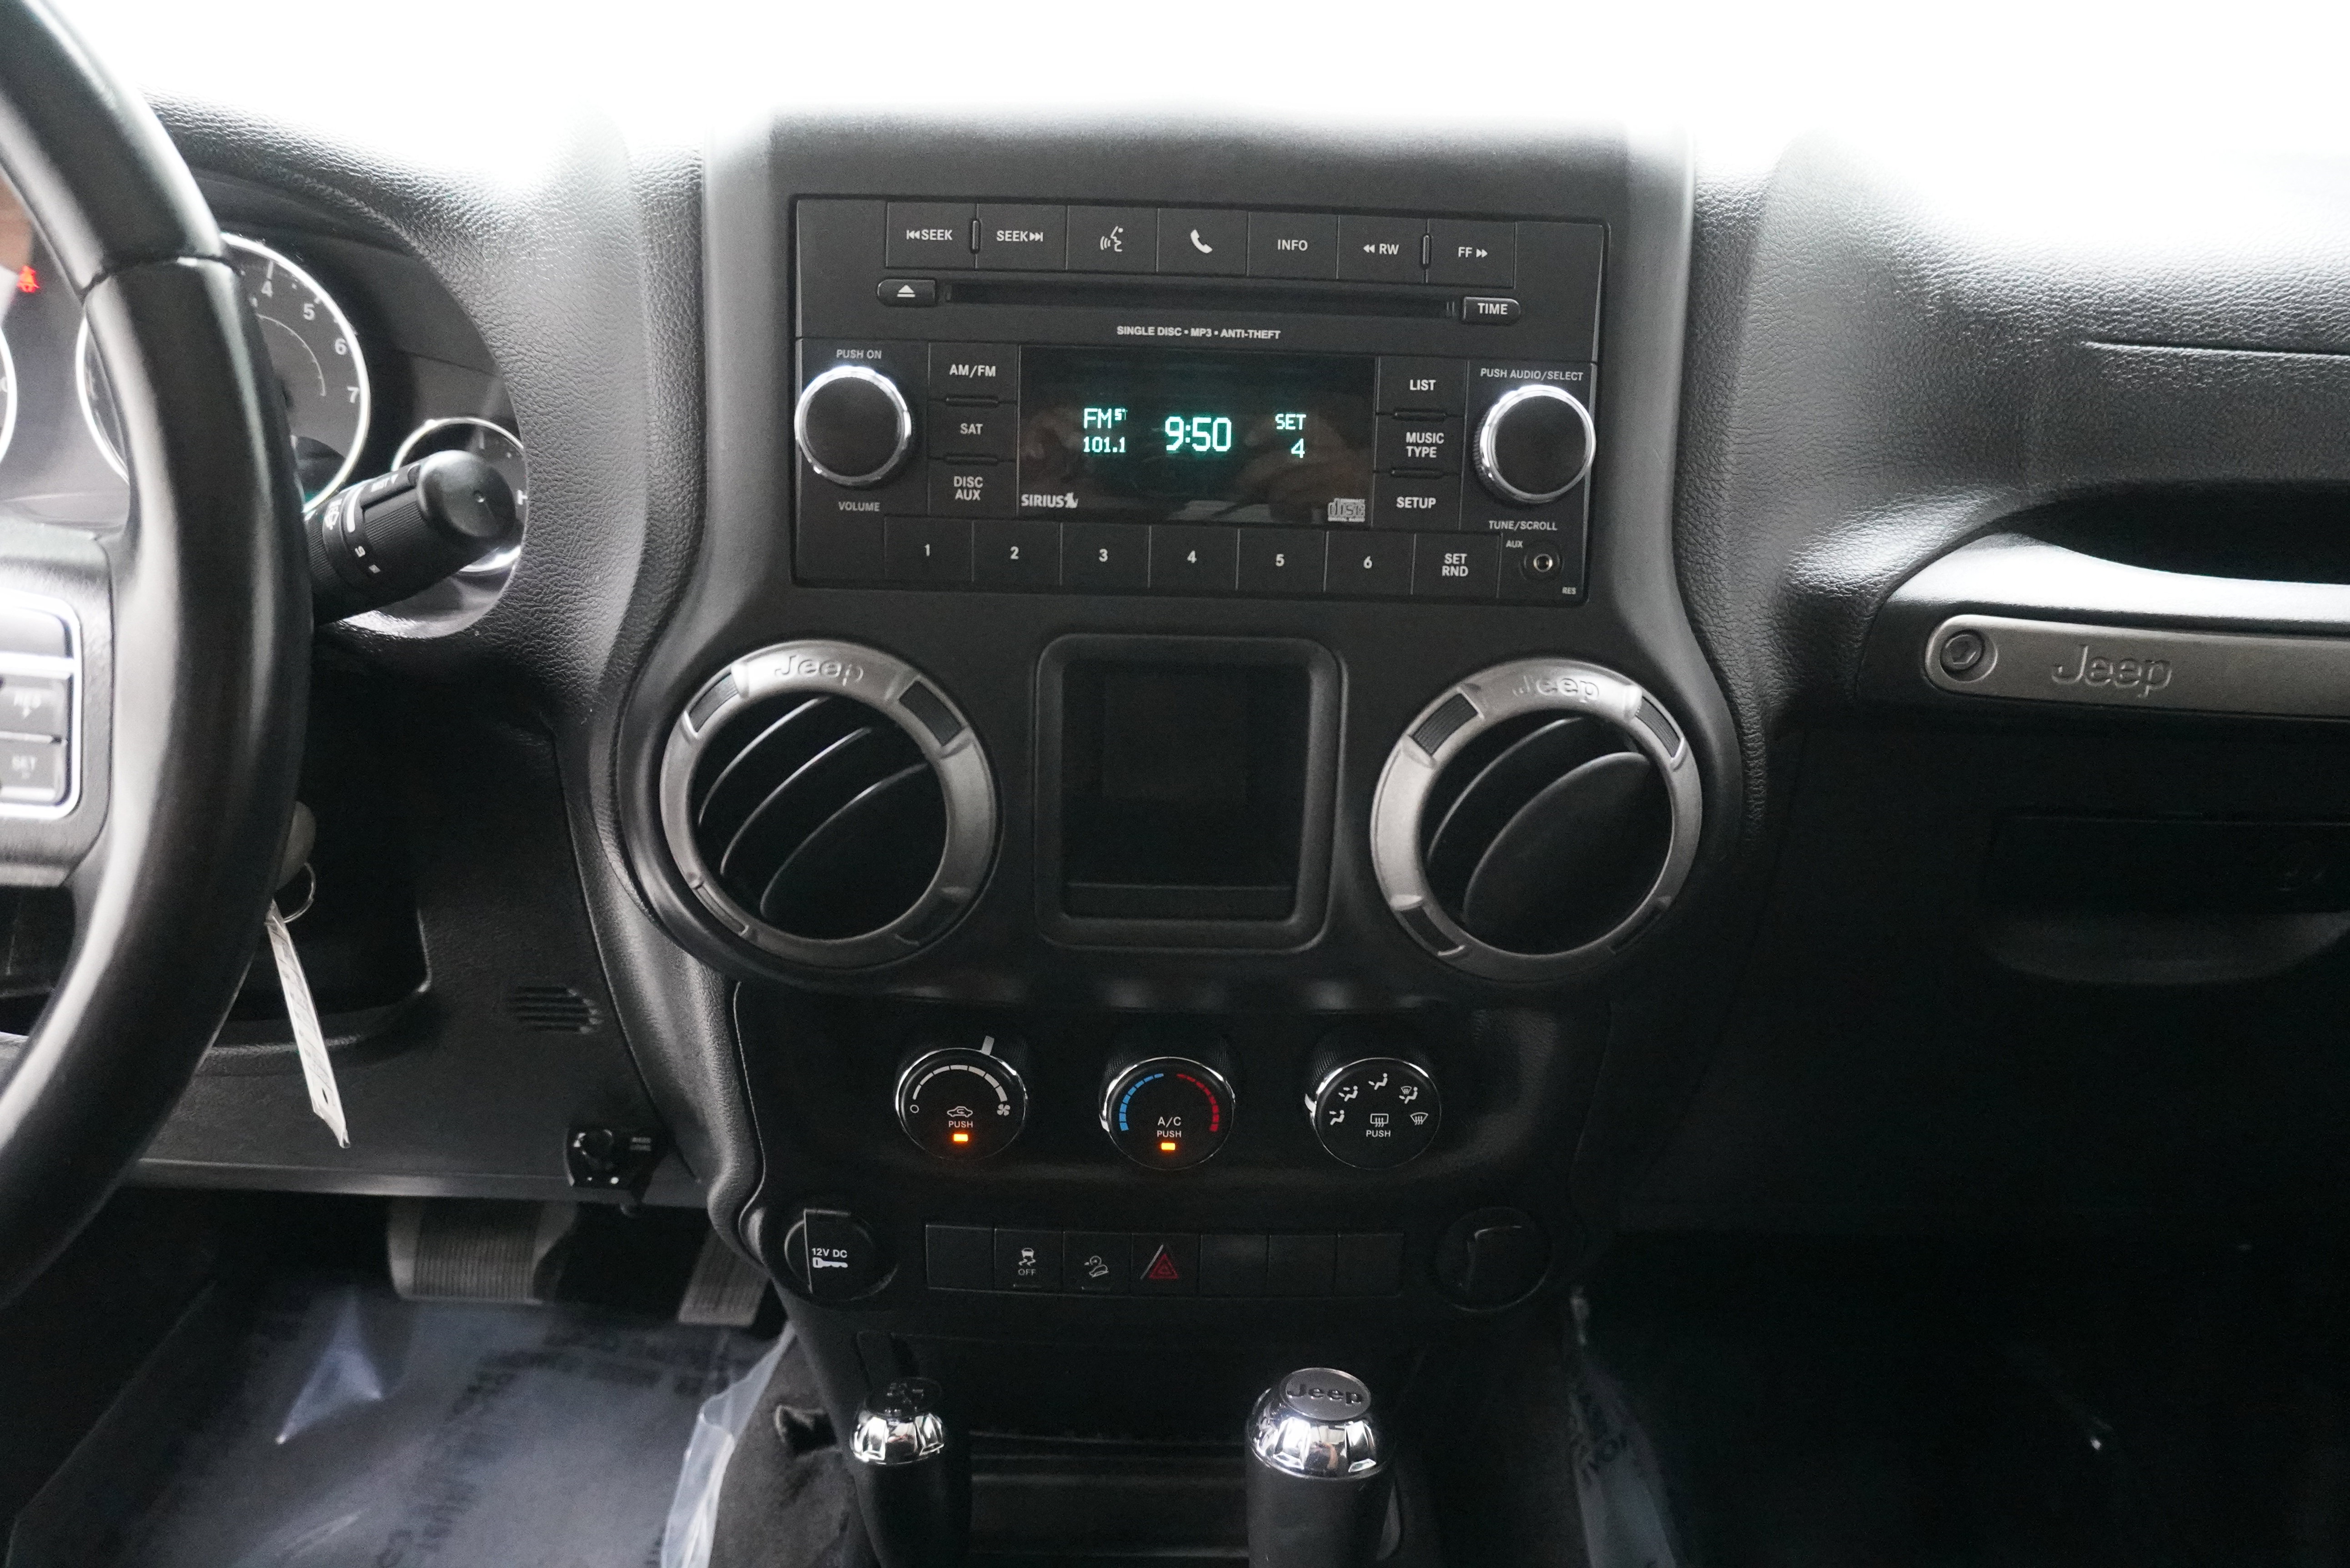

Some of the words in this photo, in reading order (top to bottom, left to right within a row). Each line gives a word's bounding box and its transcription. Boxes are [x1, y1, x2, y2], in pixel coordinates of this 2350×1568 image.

[921, 229, 952, 240] SEEK
[997, 231, 1028, 241] SEEK
[1278, 240, 1307, 251] INFO
[1380, 244, 1399, 254] RW
[1458, 247, 1472, 257] FF
[261, 281, 272, 297] 4
[304, 303, 315, 320] 5
[1478, 303, 1508, 315] TIME
[1117, 326, 1153, 335] SINGLE
[1157, 327, 1182, 336] DISC
[1191, 328, 1211, 337] MP3
[1220, 329, 1280, 339] ANTI-THEFT
[335, 338, 347, 355] 6
[837, 350, 864, 358] PUSH
[867, 350, 881, 359] ON
[949, 364, 995, 377] AM/FM
[1481, 368, 1507, 378] PUSH
[1510, 370, 1583, 381] AUDIO/SELECT
[1410, 380, 1436, 391] LIST
[347, 386, 359, 403] 7
[1084, 408, 1111, 428] FM
[1275, 414, 1306, 430] SET
[960, 423, 983, 434] SAT
[1165, 416, 1232, 452] 9:50
[1406, 432, 1444, 443] MUSIC
[1084, 437, 1125, 453] 101.1
[1291, 438, 1305, 458] 4
[1406, 446, 1436, 457] TYPE
[954, 476, 983, 488] DISC
[955, 489, 980, 500] AUX
[839, 502, 879, 511] VOLUME
[1021, 494, 1065, 508] SIRIUS
[1396, 497, 1436, 508] SETUP
[1489, 520, 1557, 531] TUNE/SCROLL
[925, 544, 930, 556] 1
[1011, 546, 1019, 559] 2
[1099, 549, 1108, 562] 3
[1187, 551, 1196, 563] 4
[1276, 554, 1284, 566] 5
[1364, 556, 1372, 568] 6
[1445, 553, 1467, 565] SET
[1442, 566, 1468, 576] RND
[774, 654, 864, 687] Jeep
[2050, 644, 2172, 699] Jeep
[1511, 675, 1600, 703] Jeep
[1158, 1116, 1181, 1127] A/C
[812, 1248, 829, 1256] 12V
[833, 1249, 847, 1258] DC
[1285, 1384, 1363, 1404] Jeep
